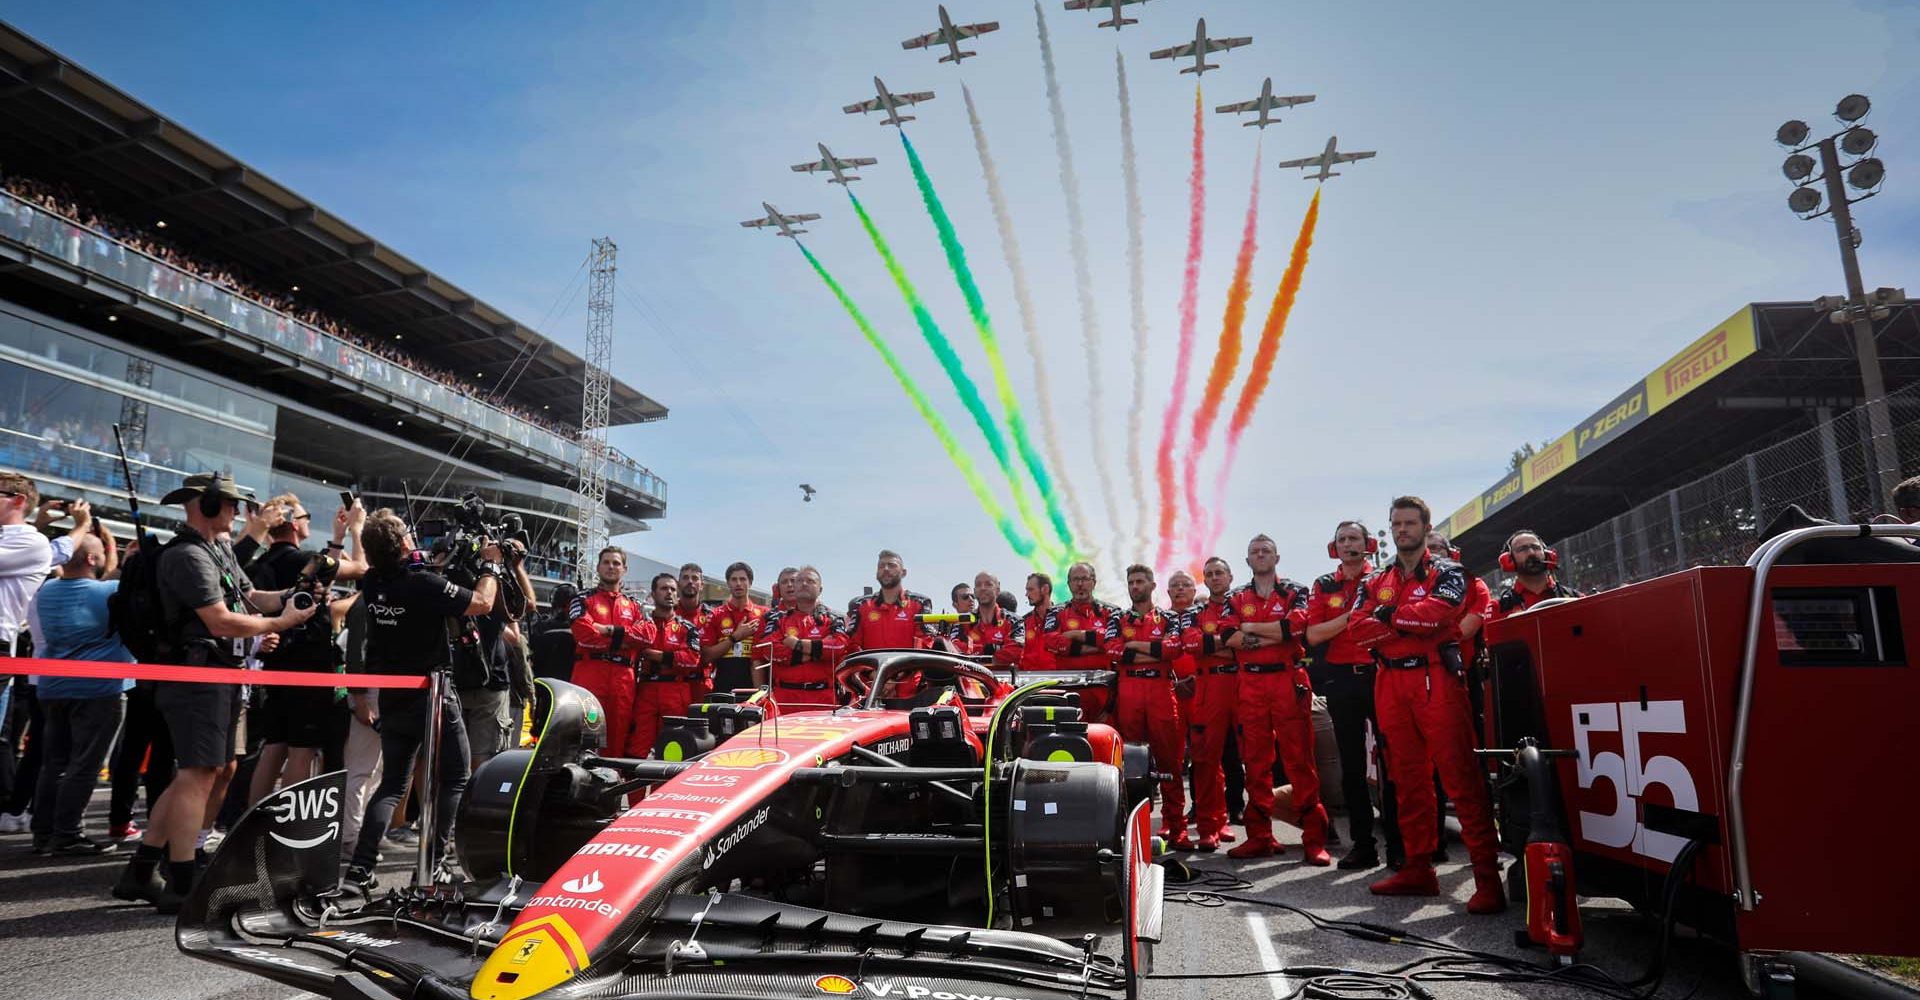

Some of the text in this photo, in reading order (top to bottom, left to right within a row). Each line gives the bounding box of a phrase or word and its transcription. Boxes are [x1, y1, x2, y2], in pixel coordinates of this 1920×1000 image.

[1664, 329, 1729, 398] PIRELLI
[1578, 391, 1644, 450] P ZERO
[1531, 442, 1564, 484] PIRELLI
[877, 738, 910, 757] RICHARD
[687, 773, 742, 783] aws
[1570, 699, 1700, 865] 55
[274, 786, 340, 824] aws
[662, 792, 730, 804] Palantir
[574, 842, 673, 863] MAHLE
[715, 806, 771, 861] Santander
[525, 893, 622, 920] antander
